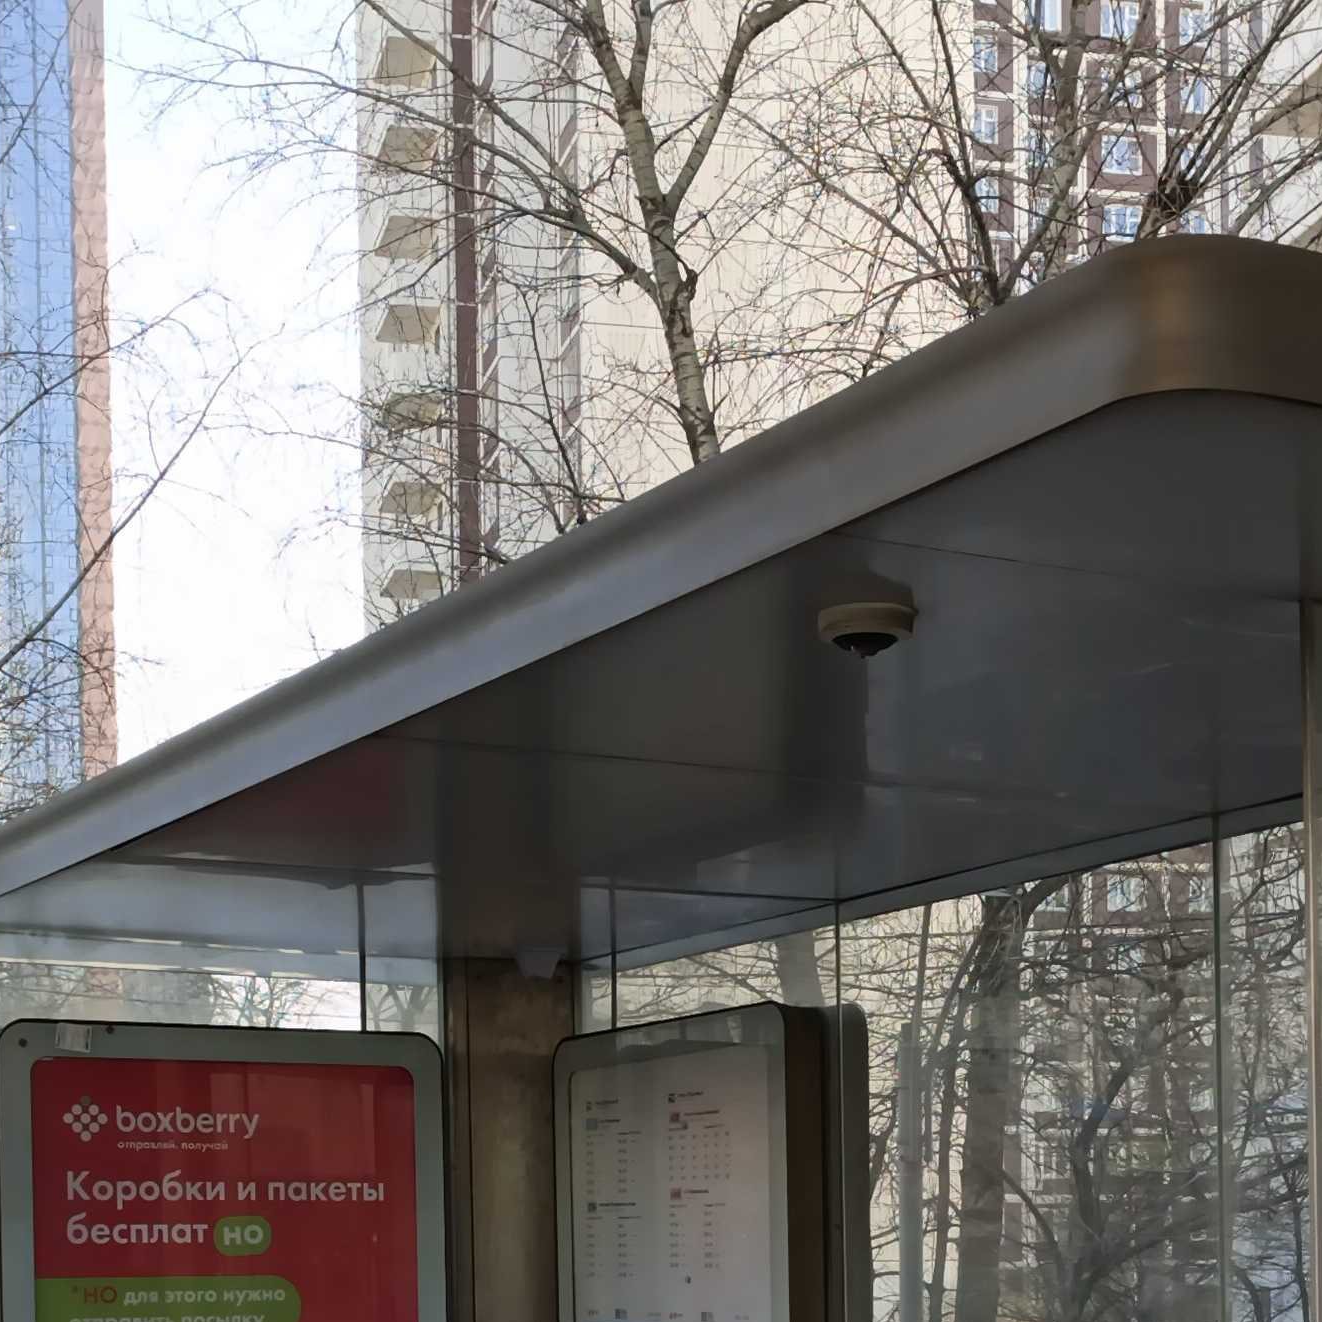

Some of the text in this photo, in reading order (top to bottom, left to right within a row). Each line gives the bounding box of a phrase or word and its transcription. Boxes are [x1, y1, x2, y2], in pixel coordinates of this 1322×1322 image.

[116, 1105, 260, 1140] boxberry
[181, 1140, 229, 1153] получай
[66, 1169, 385, 1211] Коробки и пакеты
[66, 1214, 264, 1246] бесплат но
[123, 1289, 159, 1307] для
[164, 1288, 217, 1304] этого
[223, 1288, 286, 1307] нужно
